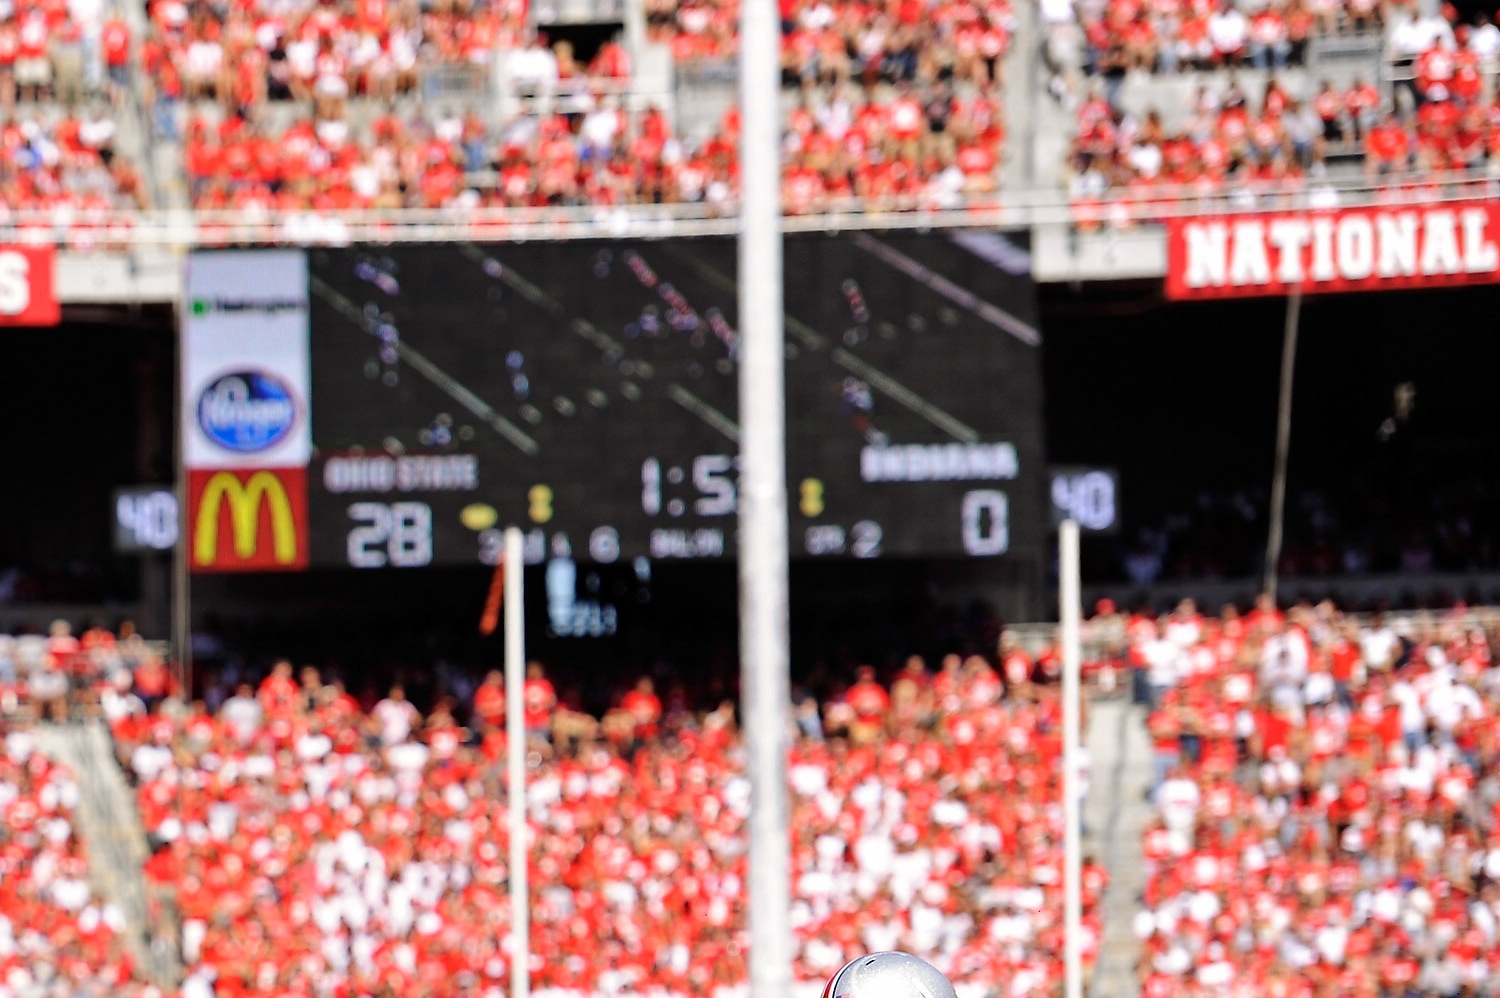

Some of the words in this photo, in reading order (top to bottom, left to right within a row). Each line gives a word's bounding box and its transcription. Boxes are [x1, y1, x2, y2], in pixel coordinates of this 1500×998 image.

[1183, 208, 1498, 288] NATIONAL
[323, 455, 396, 493] OHIO
[396, 453, 480, 492] STATE
[860, 441, 1019, 482] INDIANA
[116, 490, 179, 549] 40
[961, 489, 1009, 556] 0
[1051, 470, 1115, 530] 40
[347, 501, 434, 568] 28
[850, 519, 883, 559] 2
